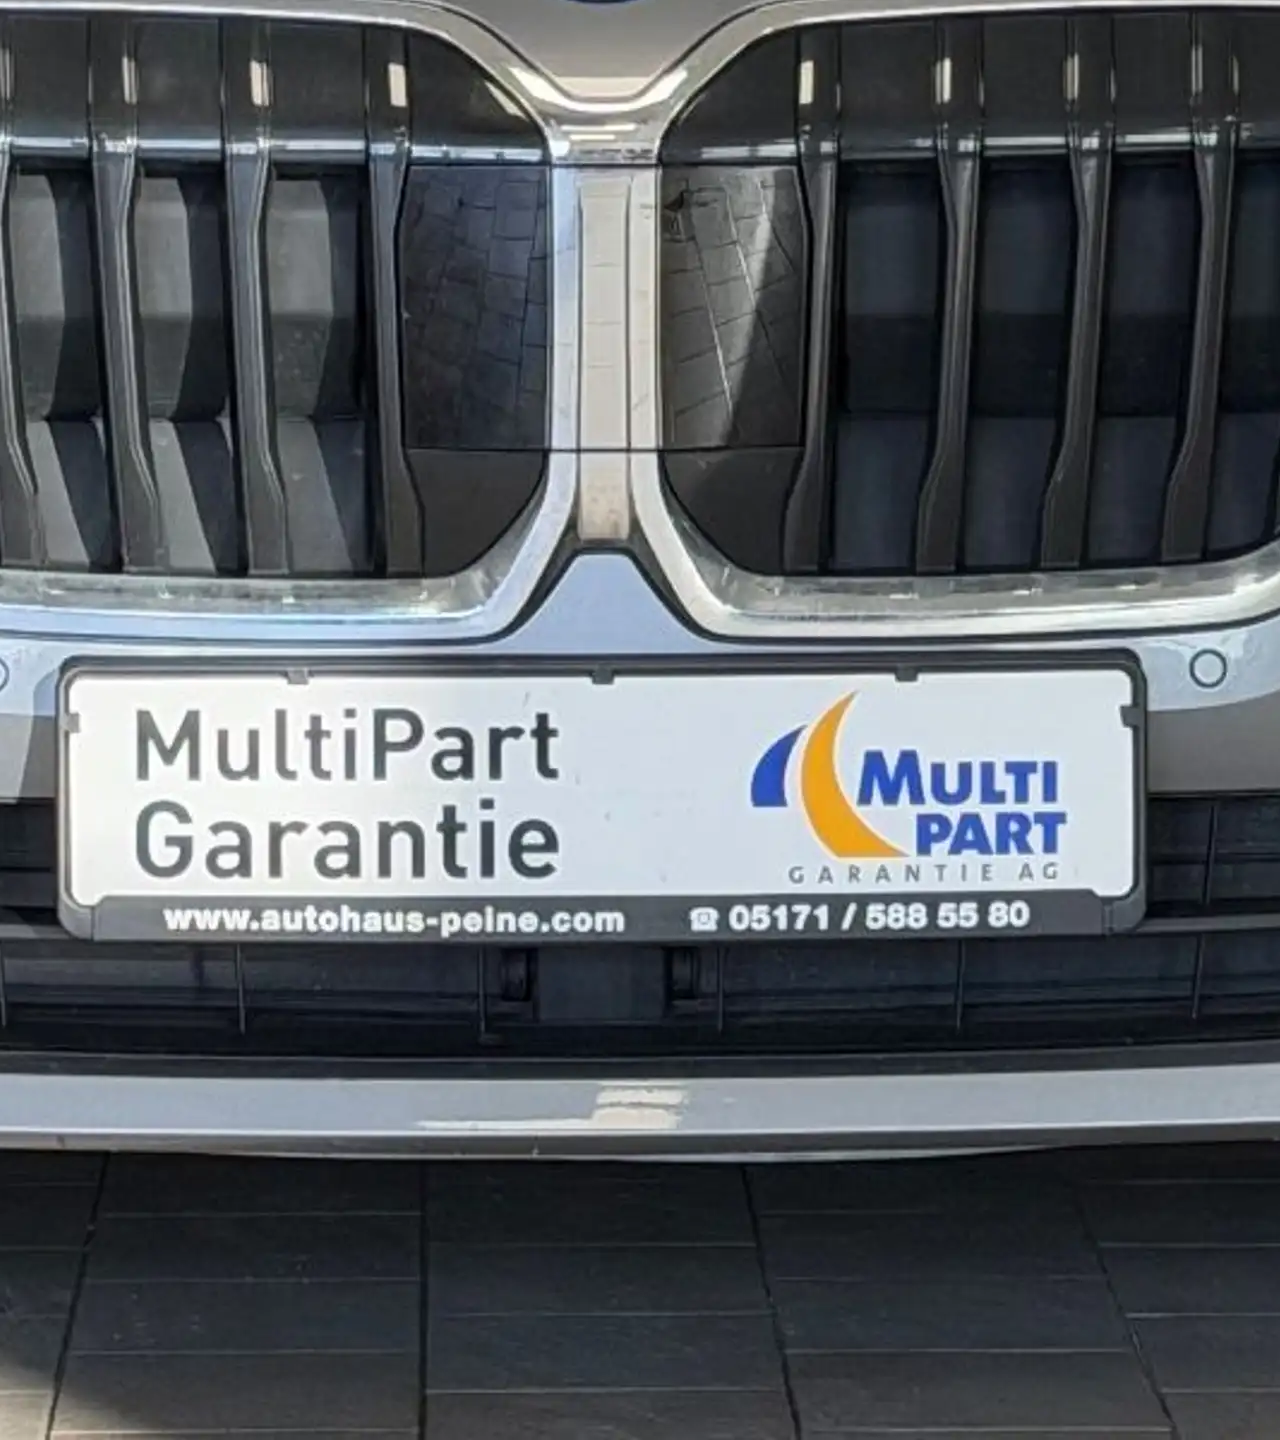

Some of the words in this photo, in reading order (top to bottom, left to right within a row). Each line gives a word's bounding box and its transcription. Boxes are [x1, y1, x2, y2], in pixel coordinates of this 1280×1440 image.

[135, 707, 560, 782] MultiPart
[856, 749, 1058, 806] MULTI
[135, 797, 560, 880] Garantie
[915, 811, 1068, 857] PART
[787, 863, 994, 884] GARANTIE
[1018, 861, 1060, 881] AG
[162, 904, 626, 938] www.autohaus-peine.com
[728, 903, 829, 932] 05171
[841, 902, 857, 931] /
[865, 902, 928, 930] 588
[937, 901, 979, 929] 55
[987, 900, 1031, 928] 80
